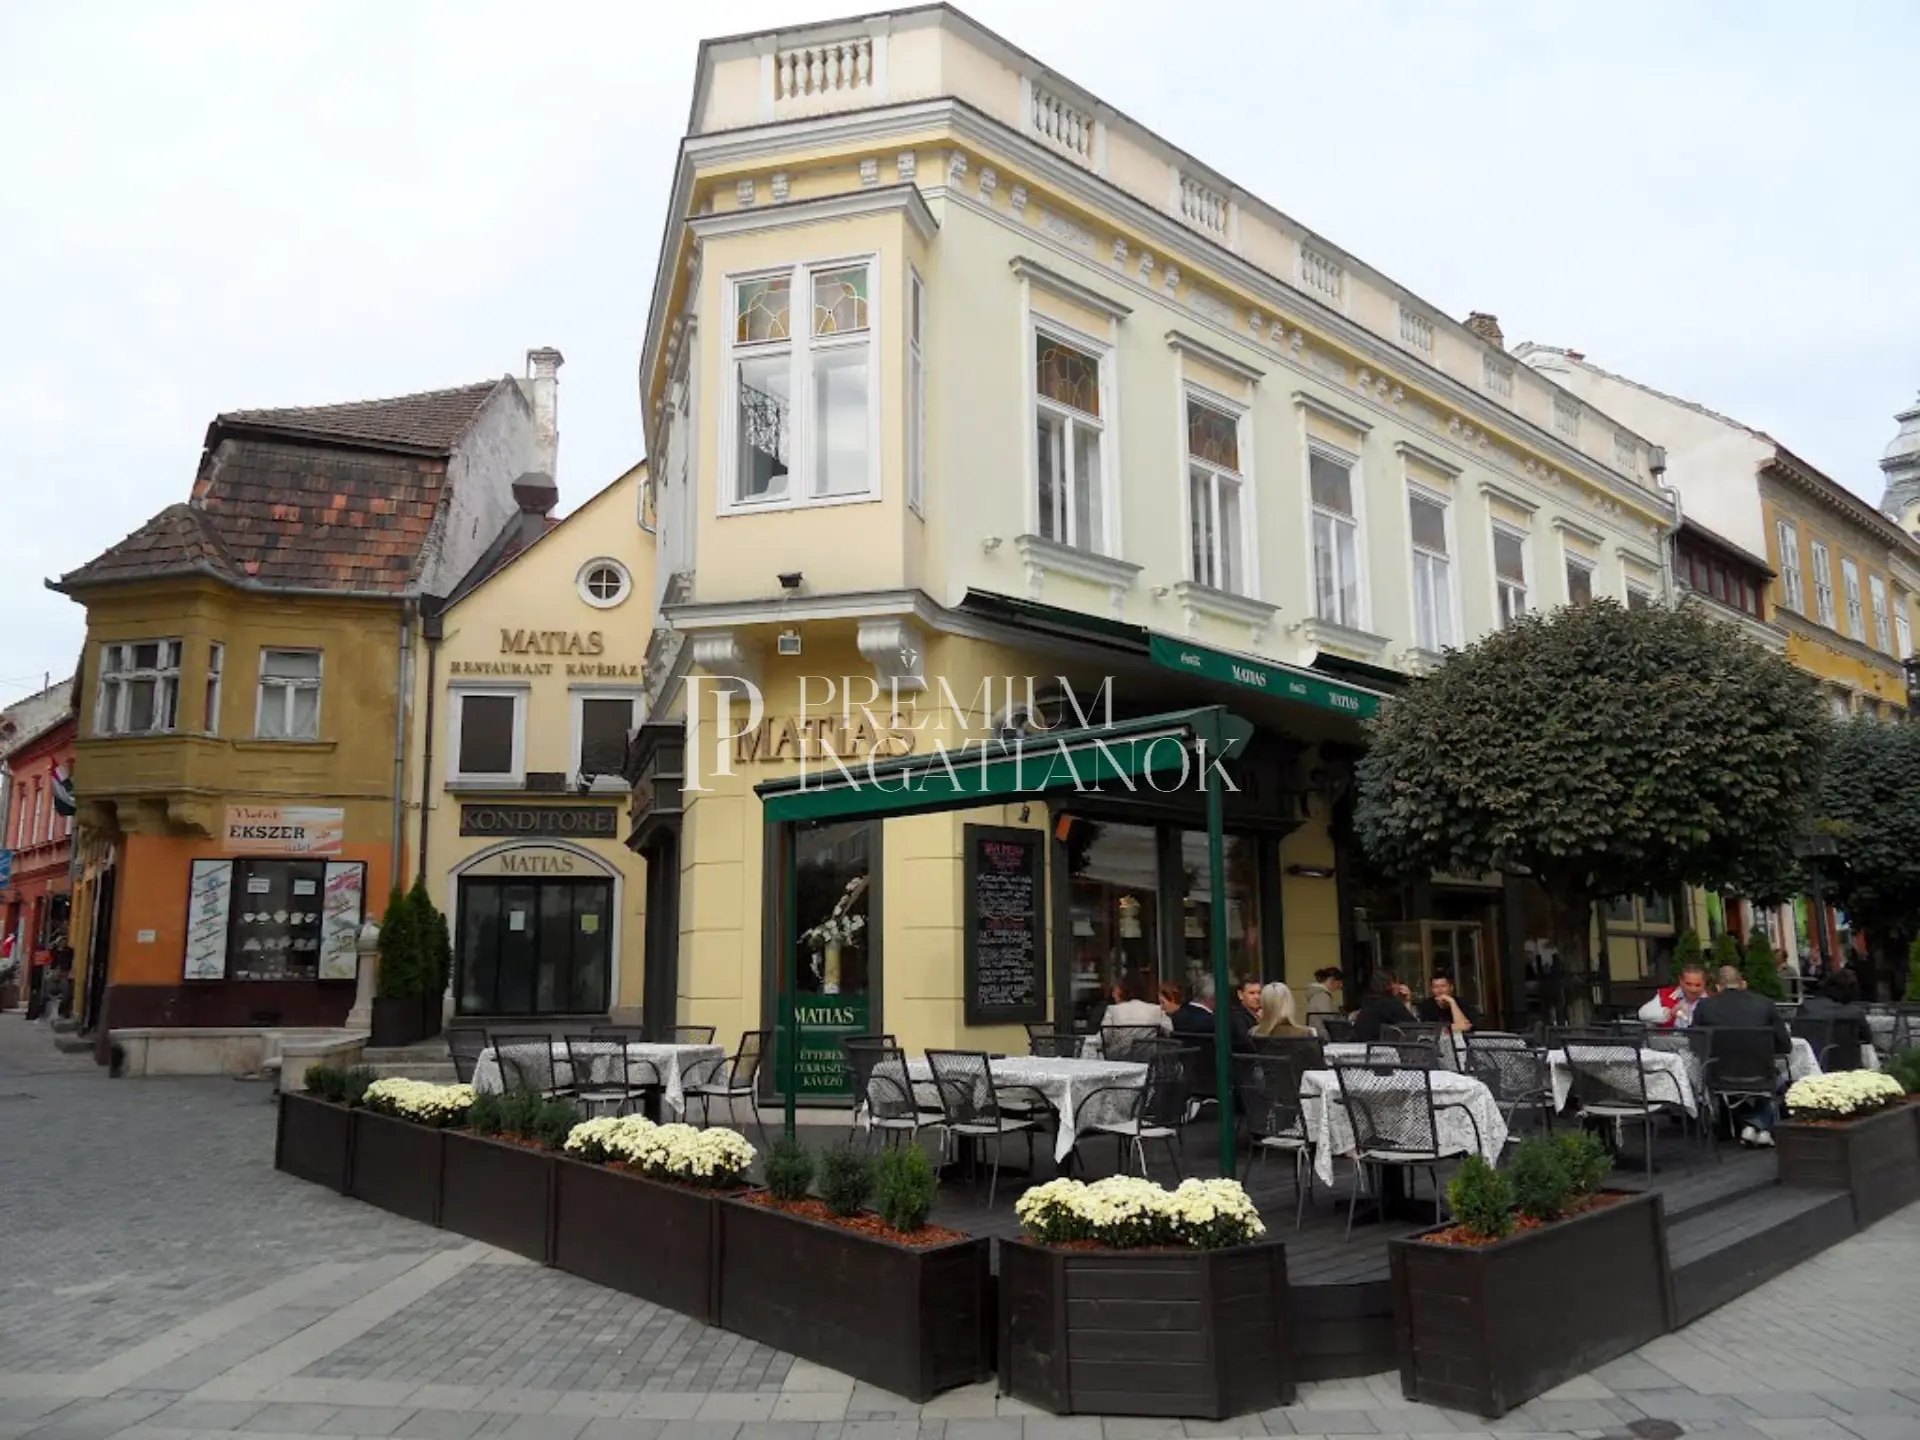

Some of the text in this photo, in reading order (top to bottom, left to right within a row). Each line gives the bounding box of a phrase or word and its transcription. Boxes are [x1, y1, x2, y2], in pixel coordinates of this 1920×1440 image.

[500, 628, 605, 655] MATIAS
[451, 661, 553, 677] RESTAURANT
[1231, 664, 1267, 687] MATIAS
[735, 709, 917, 764] MATIAS
[462, 808, 617, 832] KONDITOREI
[500, 854, 575, 873] MATIAS
[794, 1006, 855, 1025] MATIAS
